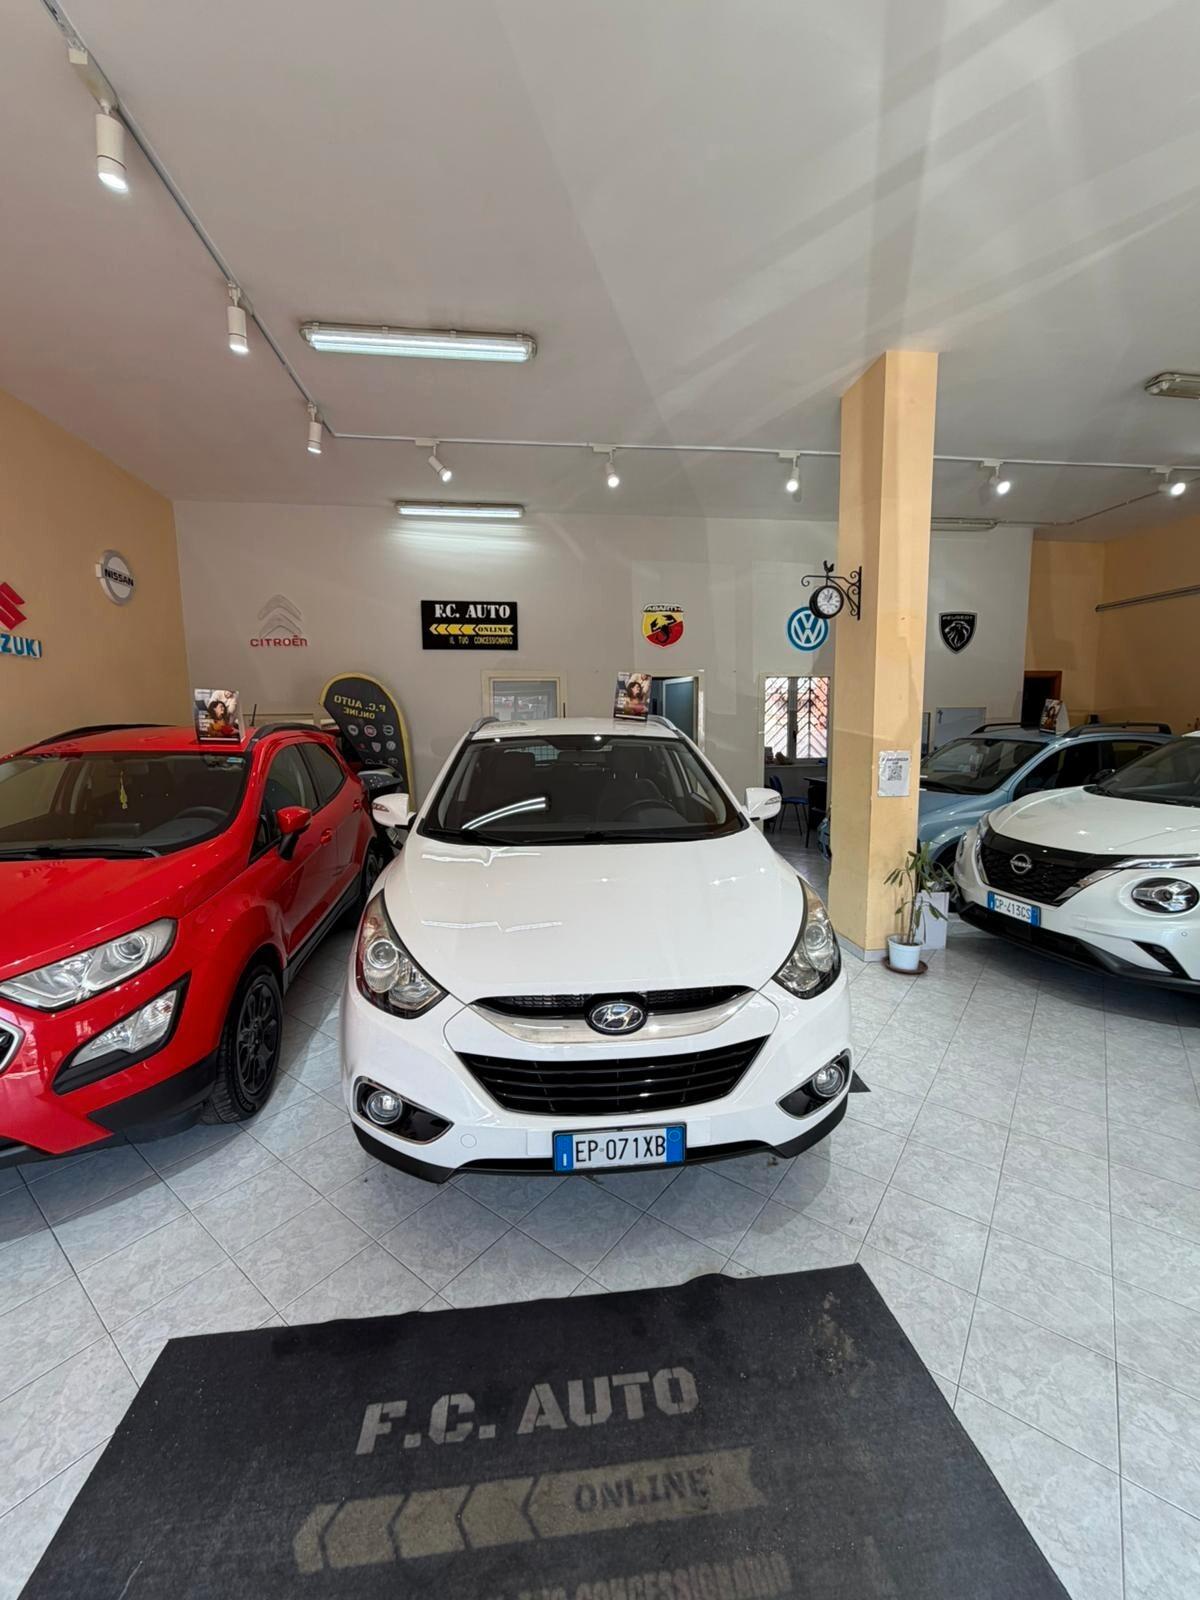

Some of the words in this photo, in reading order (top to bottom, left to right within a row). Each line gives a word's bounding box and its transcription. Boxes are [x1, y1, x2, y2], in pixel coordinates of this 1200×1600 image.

[104, 568, 134, 587] NISSAN
[434, 603, 460, 618] F.C.
[465, 604, 511, 619] AUTO
[355, 1393, 496, 1456] F.C.
[516, 1366, 700, 1435] AUTO
[574, 1466, 710, 1513] ONLINE
